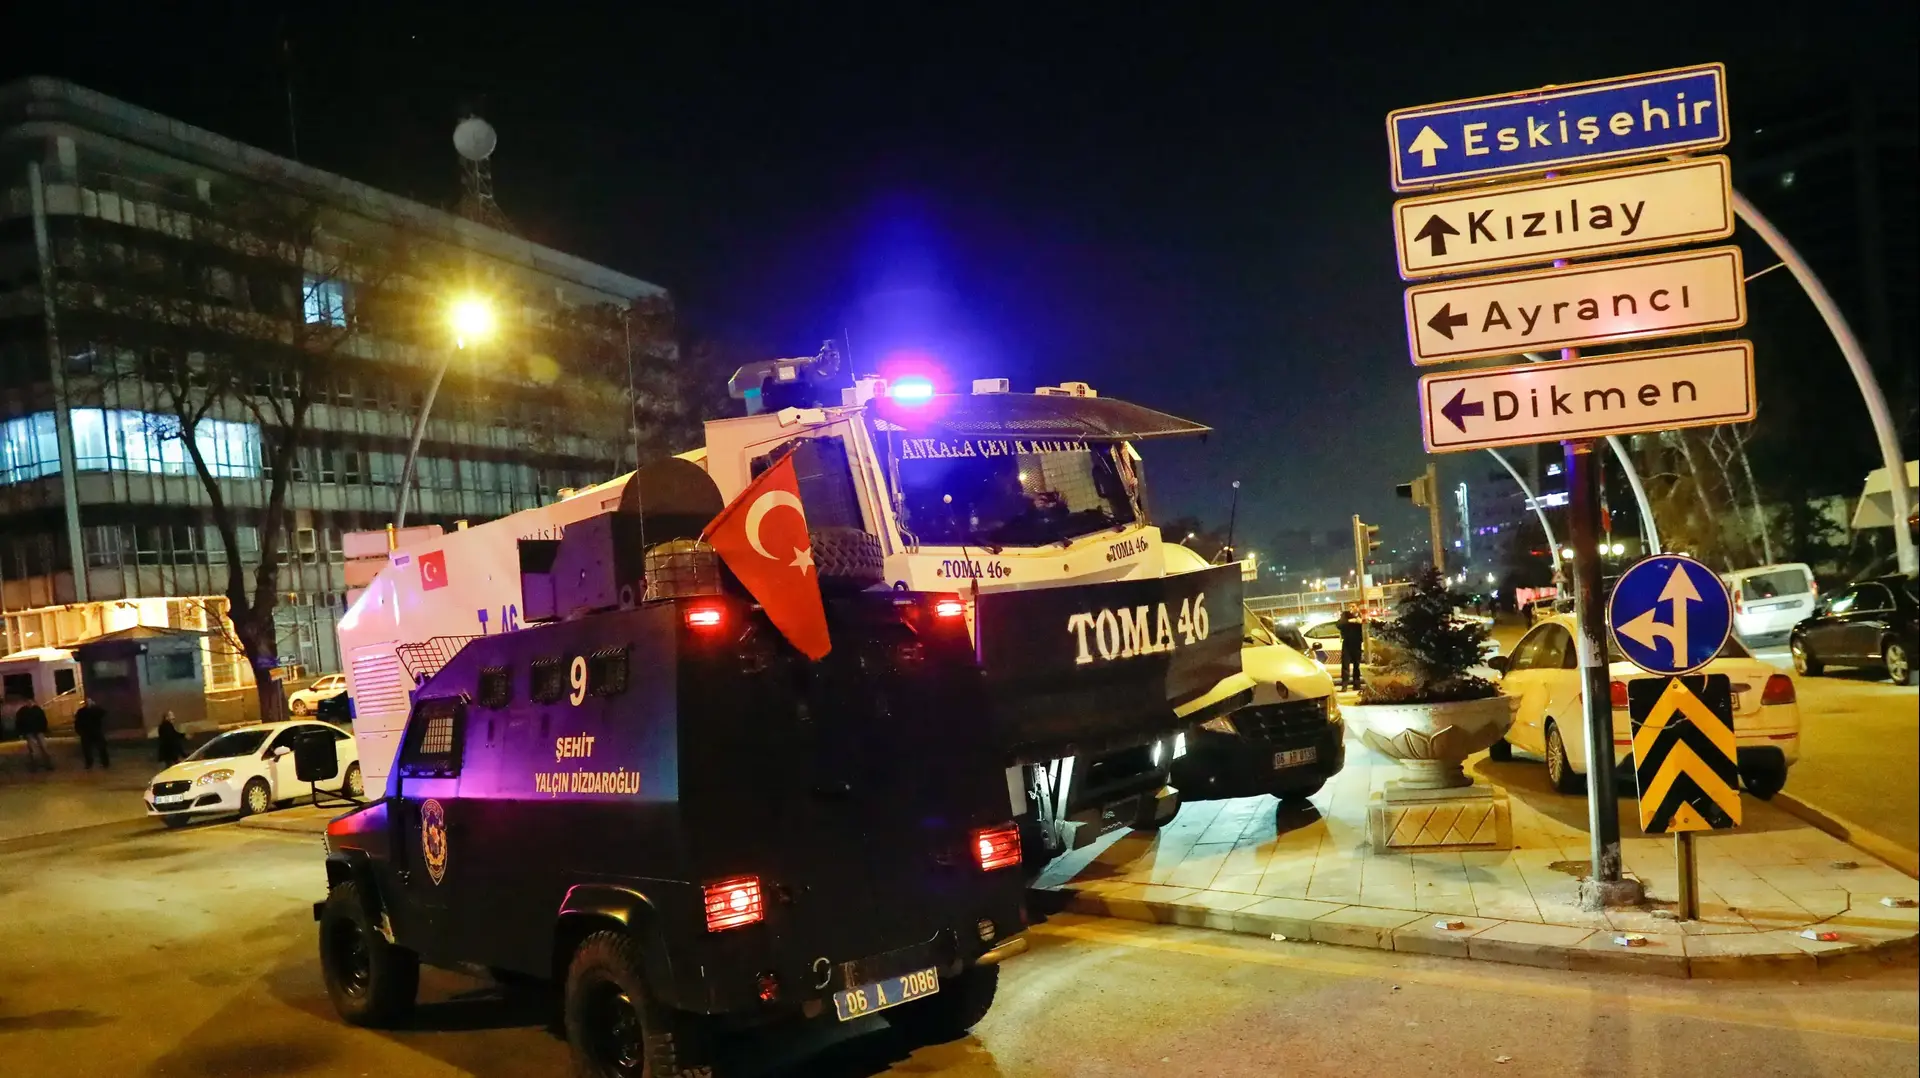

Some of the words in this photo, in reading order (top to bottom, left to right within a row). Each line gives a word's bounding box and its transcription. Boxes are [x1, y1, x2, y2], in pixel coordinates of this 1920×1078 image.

[1463, 91, 1712, 157] Eskişehir
[1467, 198, 1646, 245] Kızılay
[1481, 285, 1690, 337] Ayrancı
[1492, 379, 1697, 423] Dikmen
[977, 439, 1030, 459] ÇEVK
[942, 560, 983, 579] TOMA
[986, 560, 1003, 579] 46
[1110, 538, 1136, 562] TOMA
[1135, 535, 1146, 553] 46
[1067, 603, 1175, 664] TOMA
[1177, 593, 1209, 645] 46
[569, 655, 588, 707] 9
[555, 731, 595, 763] ŞEHİT
[535, 772, 569, 798] YALÇIN
[571, 766, 641, 795] DİZDAROĞLU
[847, 989, 867, 1013] 06
[877, 984, 887, 1005] A
[900, 970, 935, 997] 2086
